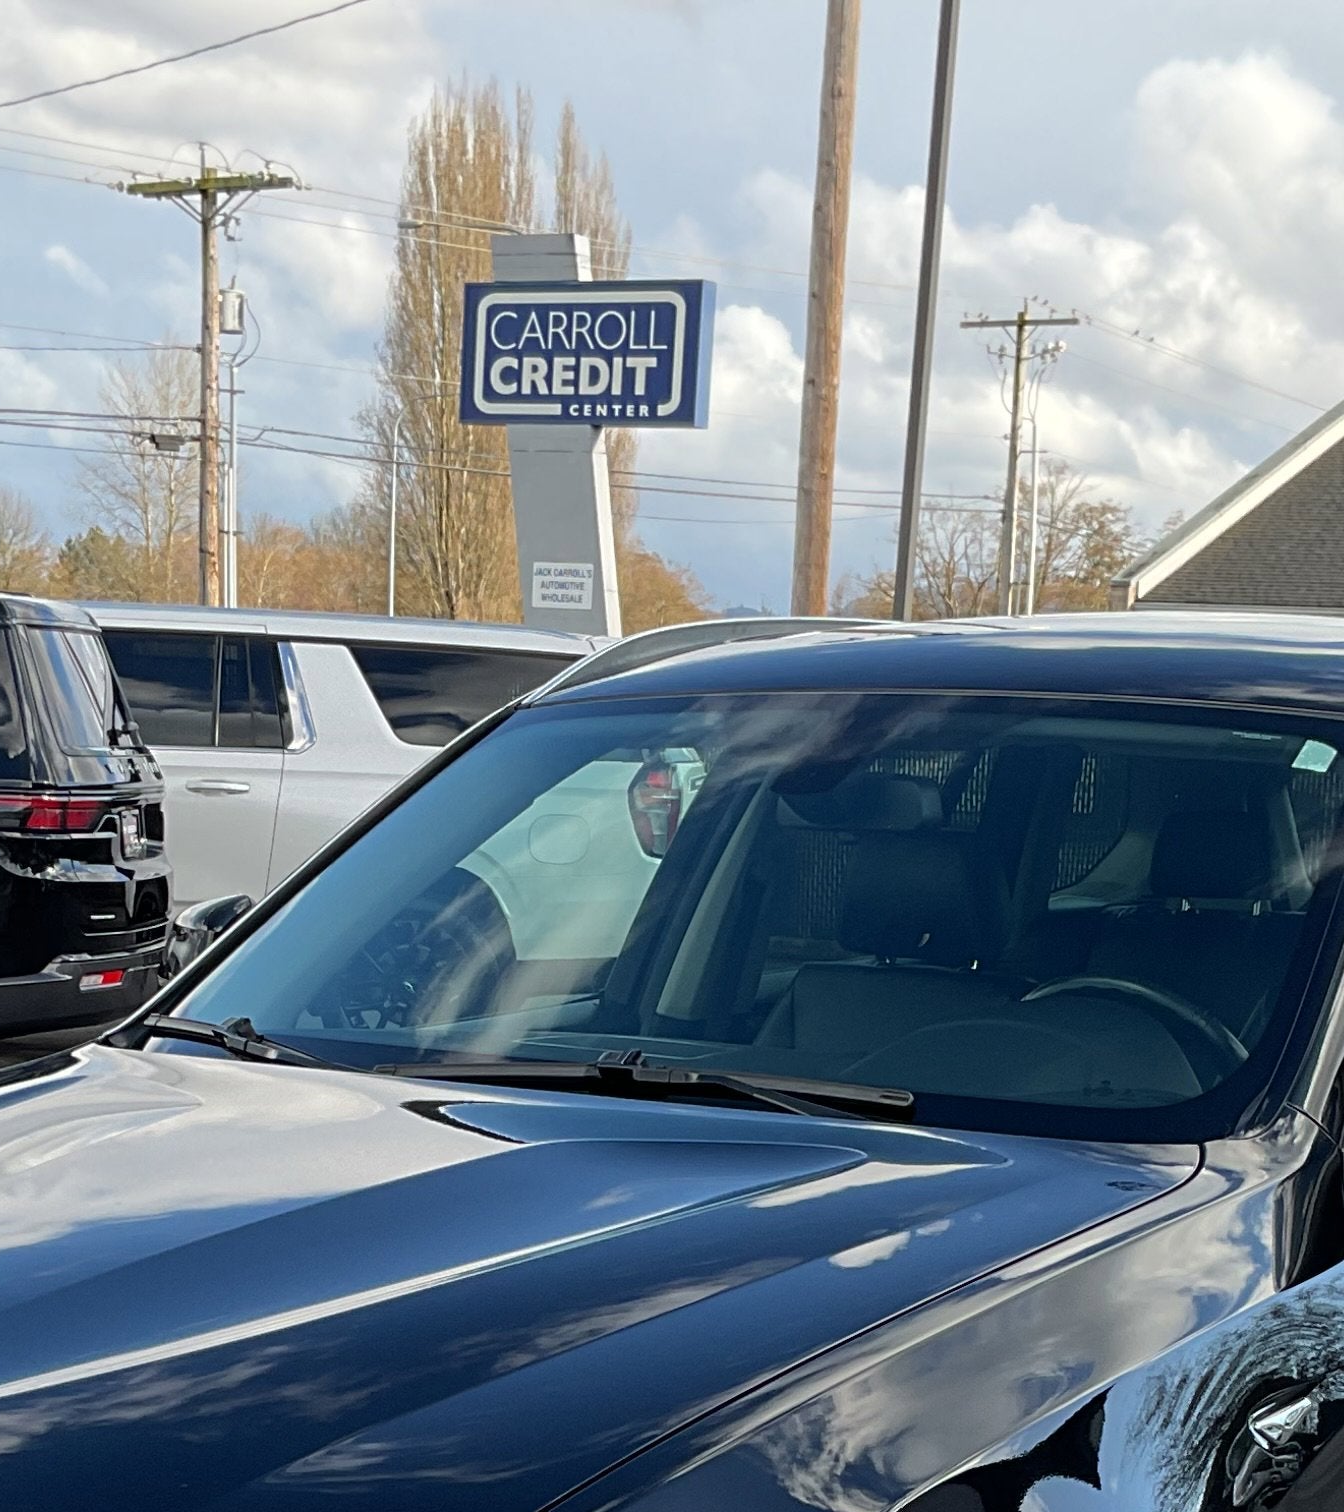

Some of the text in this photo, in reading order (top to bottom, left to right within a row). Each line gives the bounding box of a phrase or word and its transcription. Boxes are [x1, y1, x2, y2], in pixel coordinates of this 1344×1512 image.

[490, 309, 668, 350] CARROLL
[489, 356, 657, 396] CREDIT
[569, 404, 649, 417] CENTER
[534, 568, 551, 576] JACK
[541, 581, 584, 590] AUTOMOTIVE
[541, 594, 583, 603] WHOLESALE
